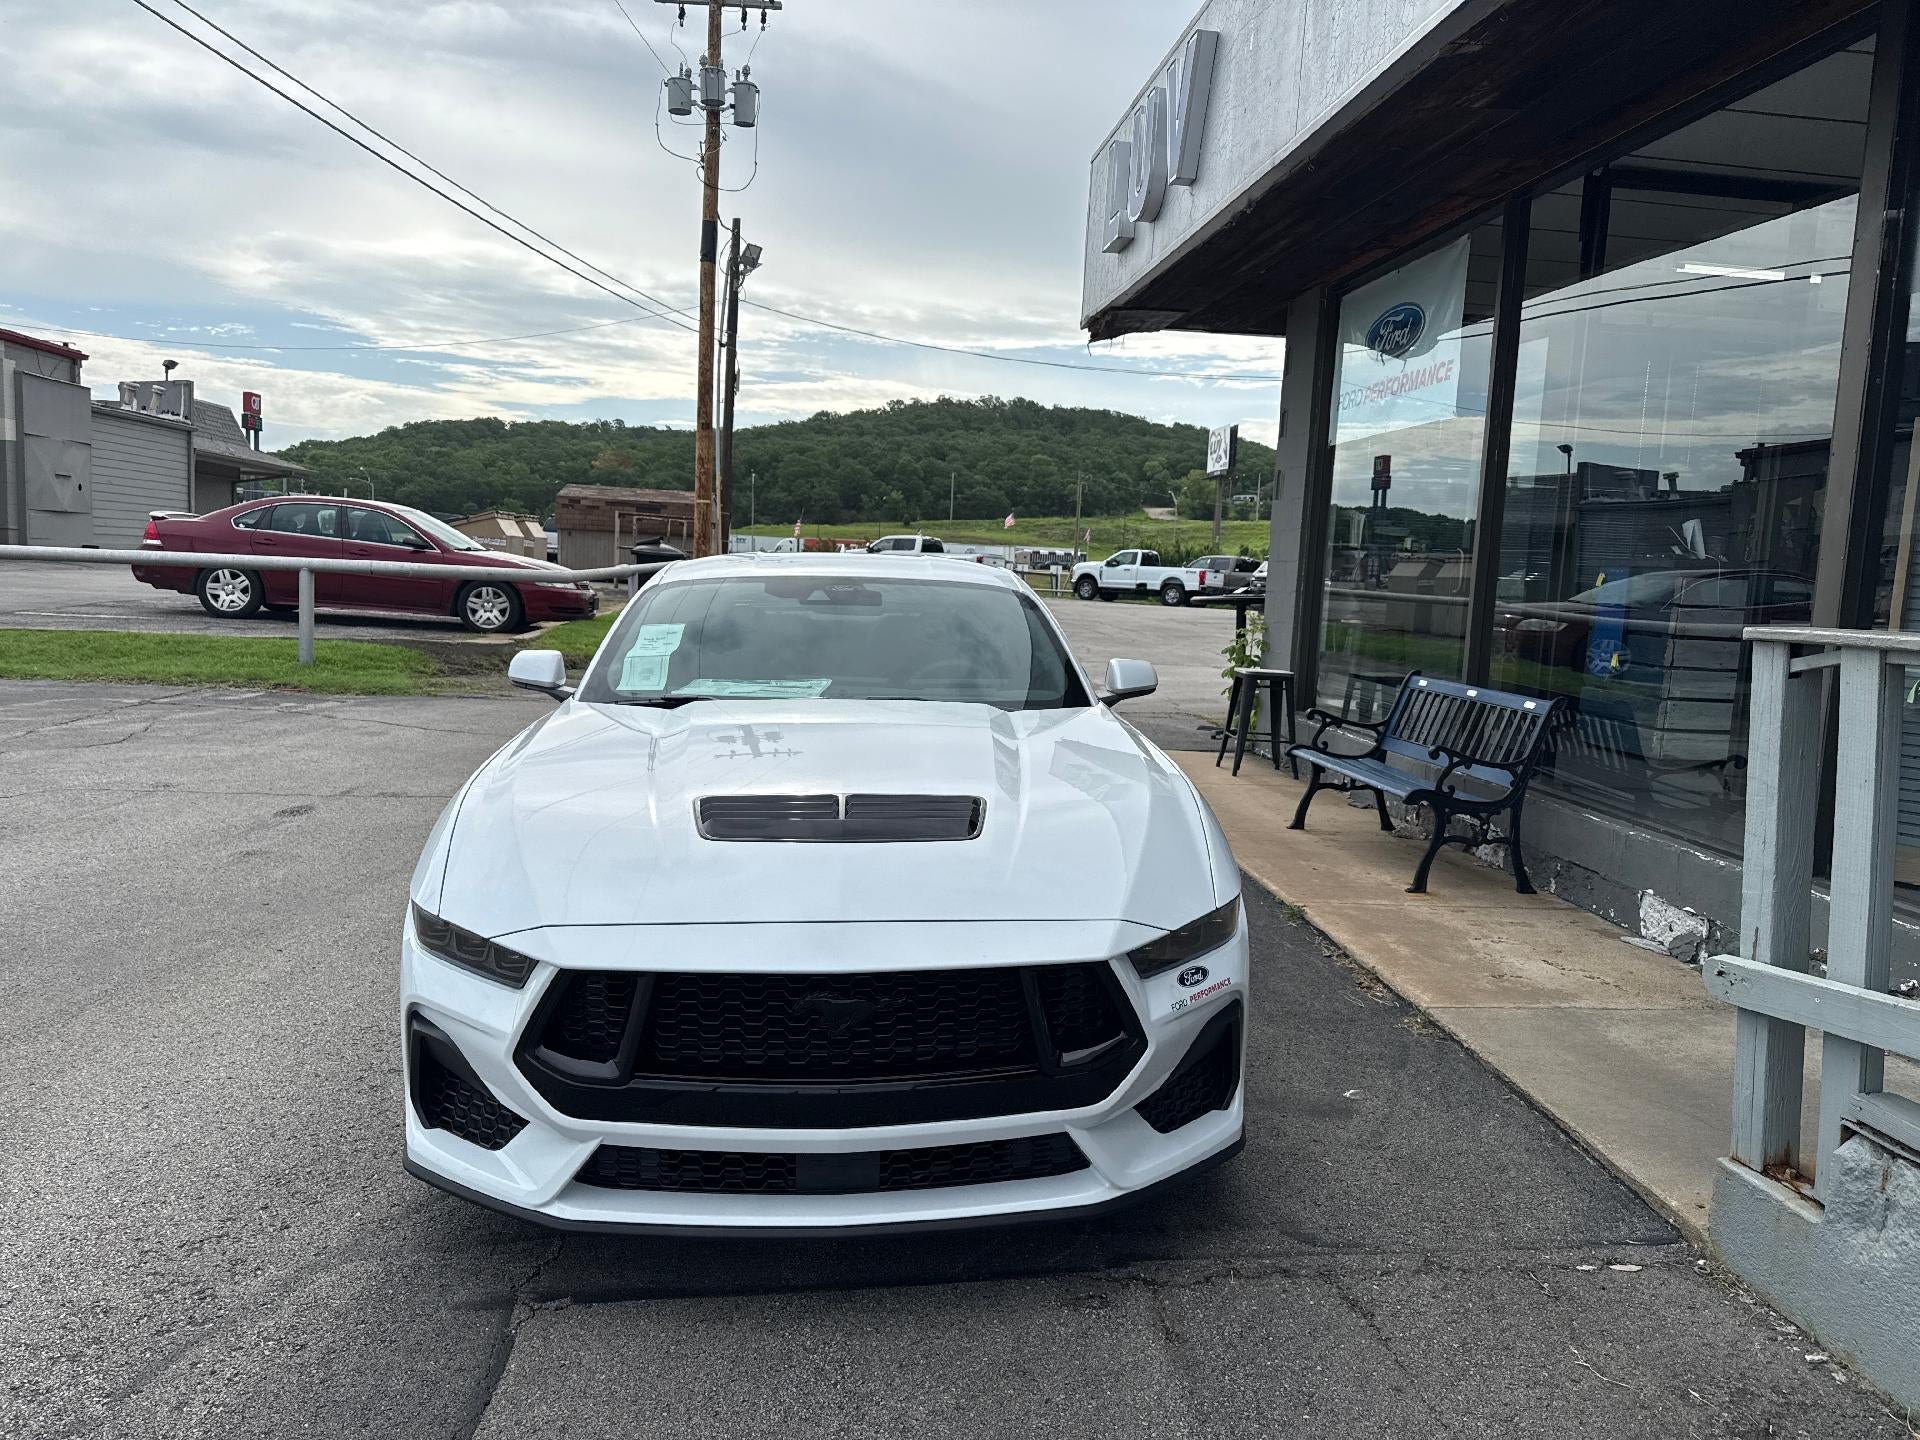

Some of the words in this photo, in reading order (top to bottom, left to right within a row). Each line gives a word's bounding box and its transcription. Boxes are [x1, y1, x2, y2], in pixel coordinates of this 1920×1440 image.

[1374, 313, 1412, 351] Ford
[1363, 359, 1454, 406] PERFORMANCE
[1171, 999, 1188, 1012] FORD
[1189, 977, 1232, 1003] PERFORMANCE
[1183, 969, 1204, 985] Ford
